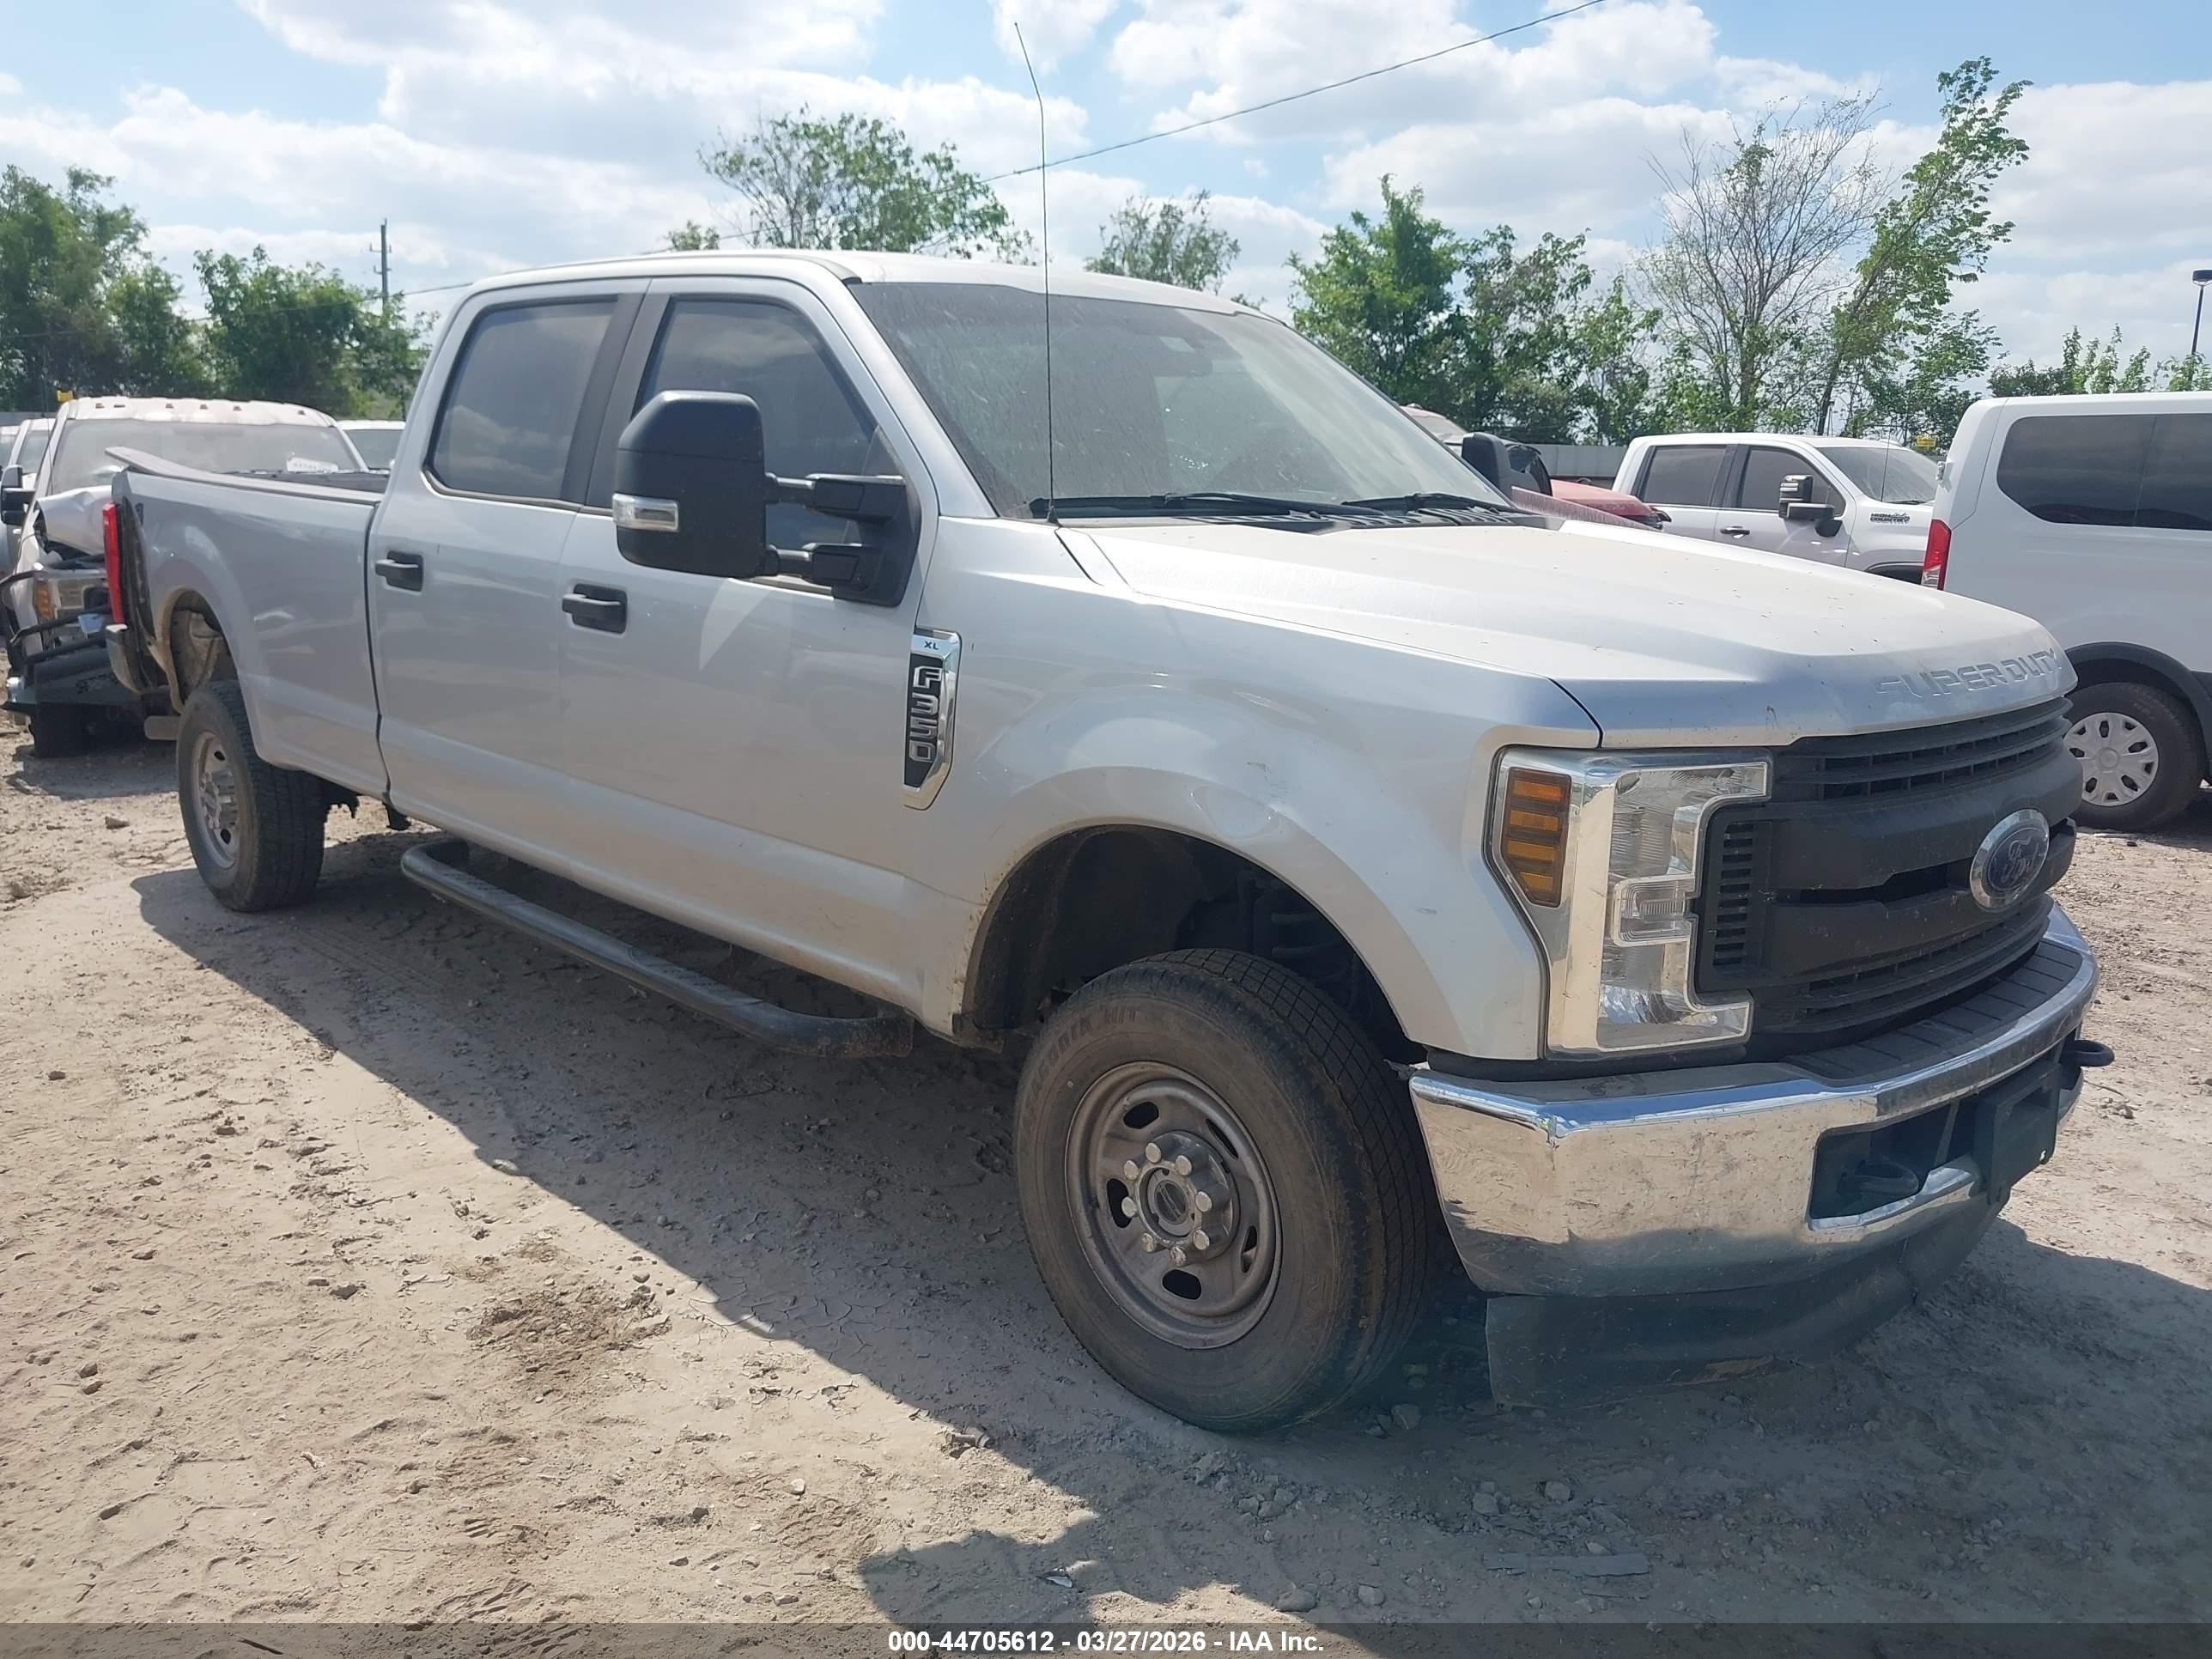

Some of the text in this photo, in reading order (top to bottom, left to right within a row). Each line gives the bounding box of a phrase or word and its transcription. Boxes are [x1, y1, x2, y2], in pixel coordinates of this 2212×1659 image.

[924, 640, 939, 651] XL
[1875, 647, 2062, 700] SUPER DUTY
